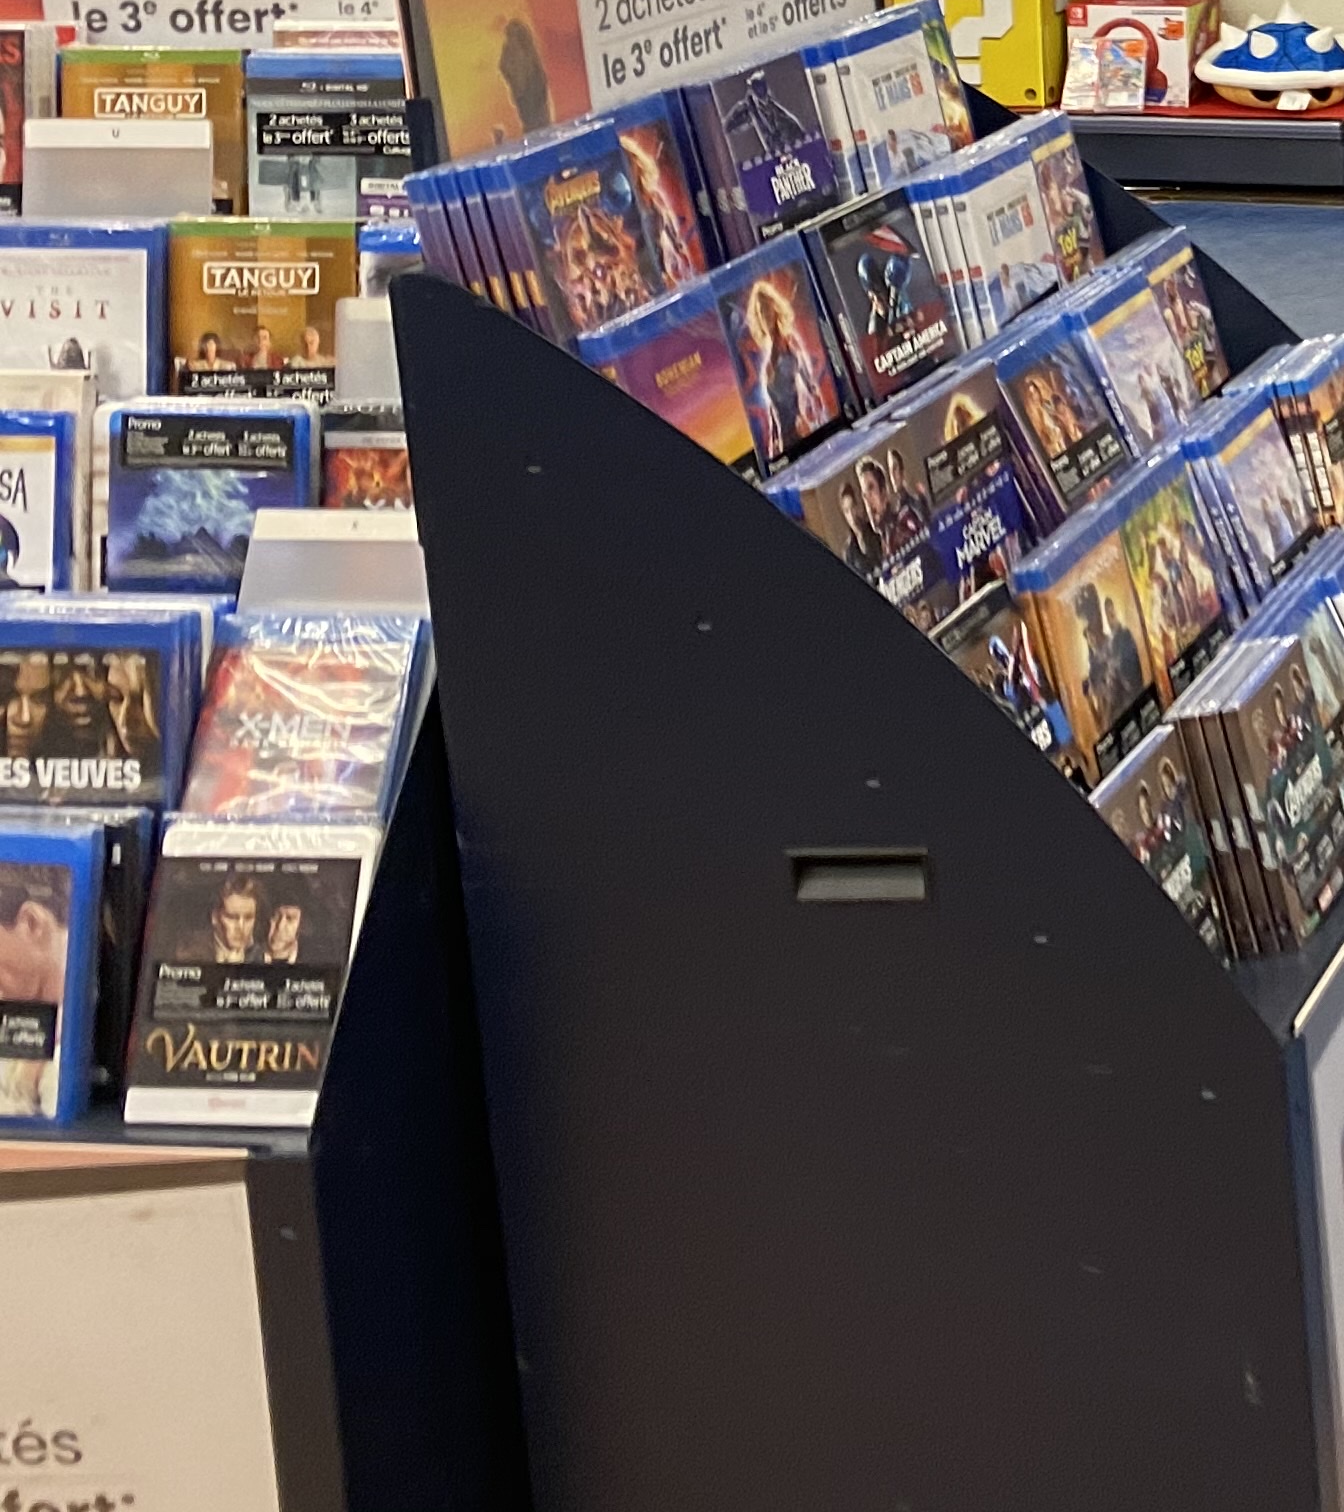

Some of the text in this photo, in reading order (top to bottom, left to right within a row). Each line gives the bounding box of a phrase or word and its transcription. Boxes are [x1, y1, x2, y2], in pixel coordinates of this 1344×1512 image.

[603, 52, 627, 88] le
[100, 93, 201, 114] TANGUY
[211, 268, 313, 288] TANGUY
[0, 299, 110, 321] VISIT
[129, 417, 161, 431] Promo
[36, 758, 141, 789] VEUVES
[147, 1023, 320, 1073] VAUTRIN
